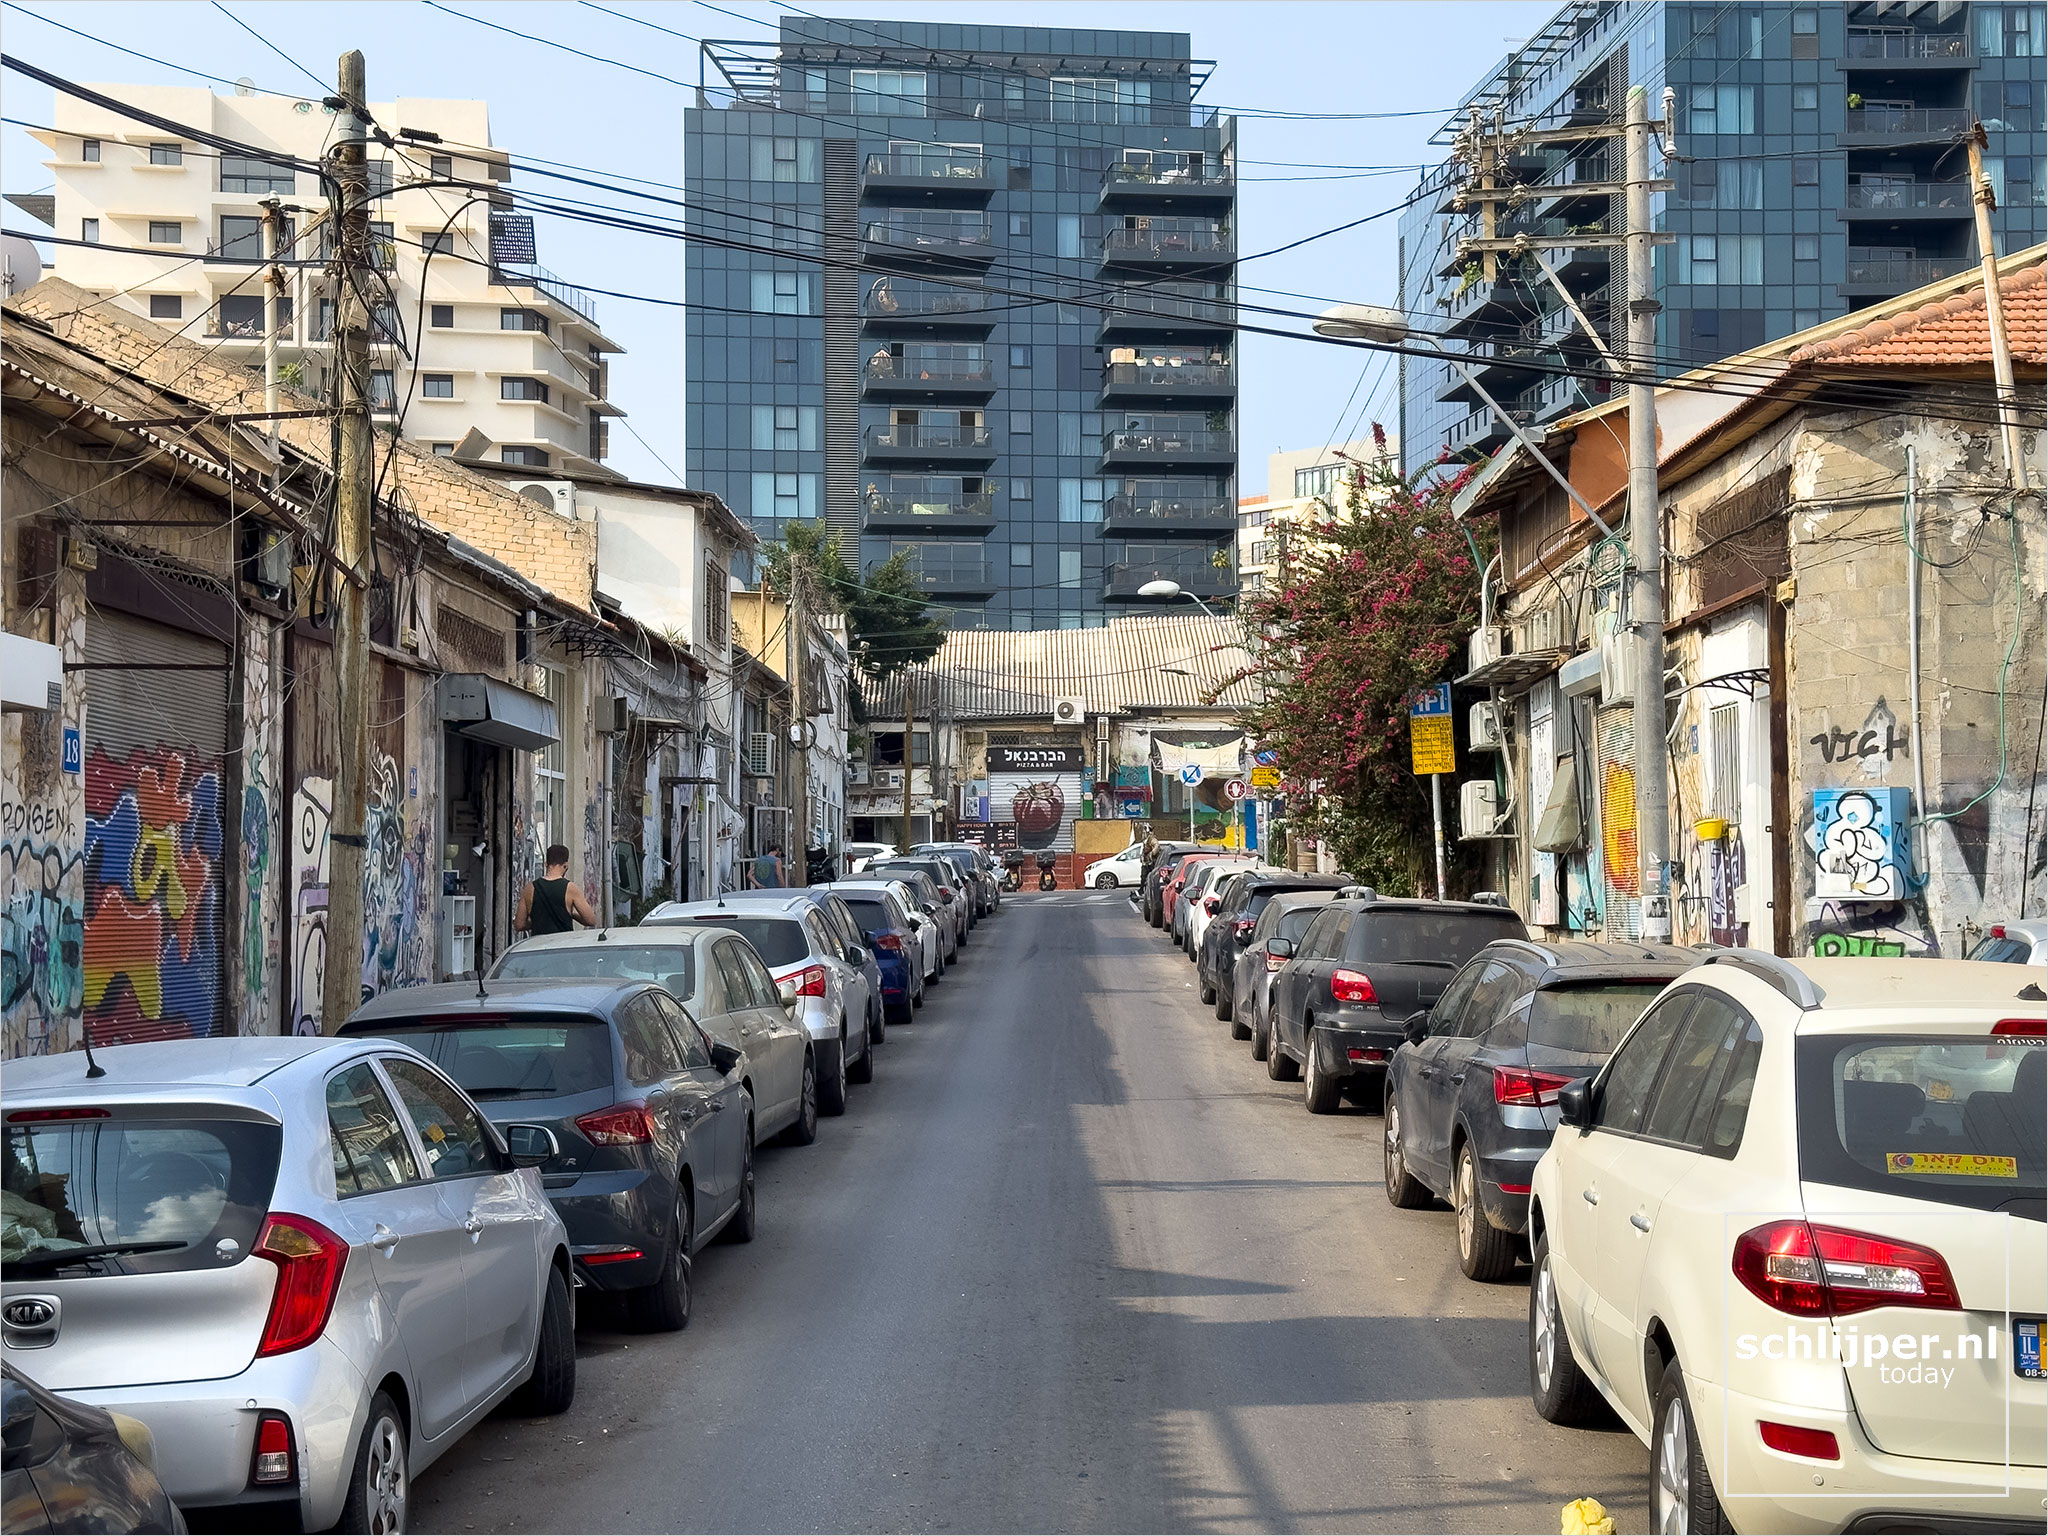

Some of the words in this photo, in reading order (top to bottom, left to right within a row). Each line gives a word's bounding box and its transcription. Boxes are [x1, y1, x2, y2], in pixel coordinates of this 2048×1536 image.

[65, 737, 79, 763] 18
[1004, 749, 1067, 762] הברבנאל
[1918, 1153, 1963, 1166] קאר
[1972, 1155, 2014, 1168] נייס
[10, 1306, 46, 1323] KIA
[2022, 1336, 2036, 1354] IL
